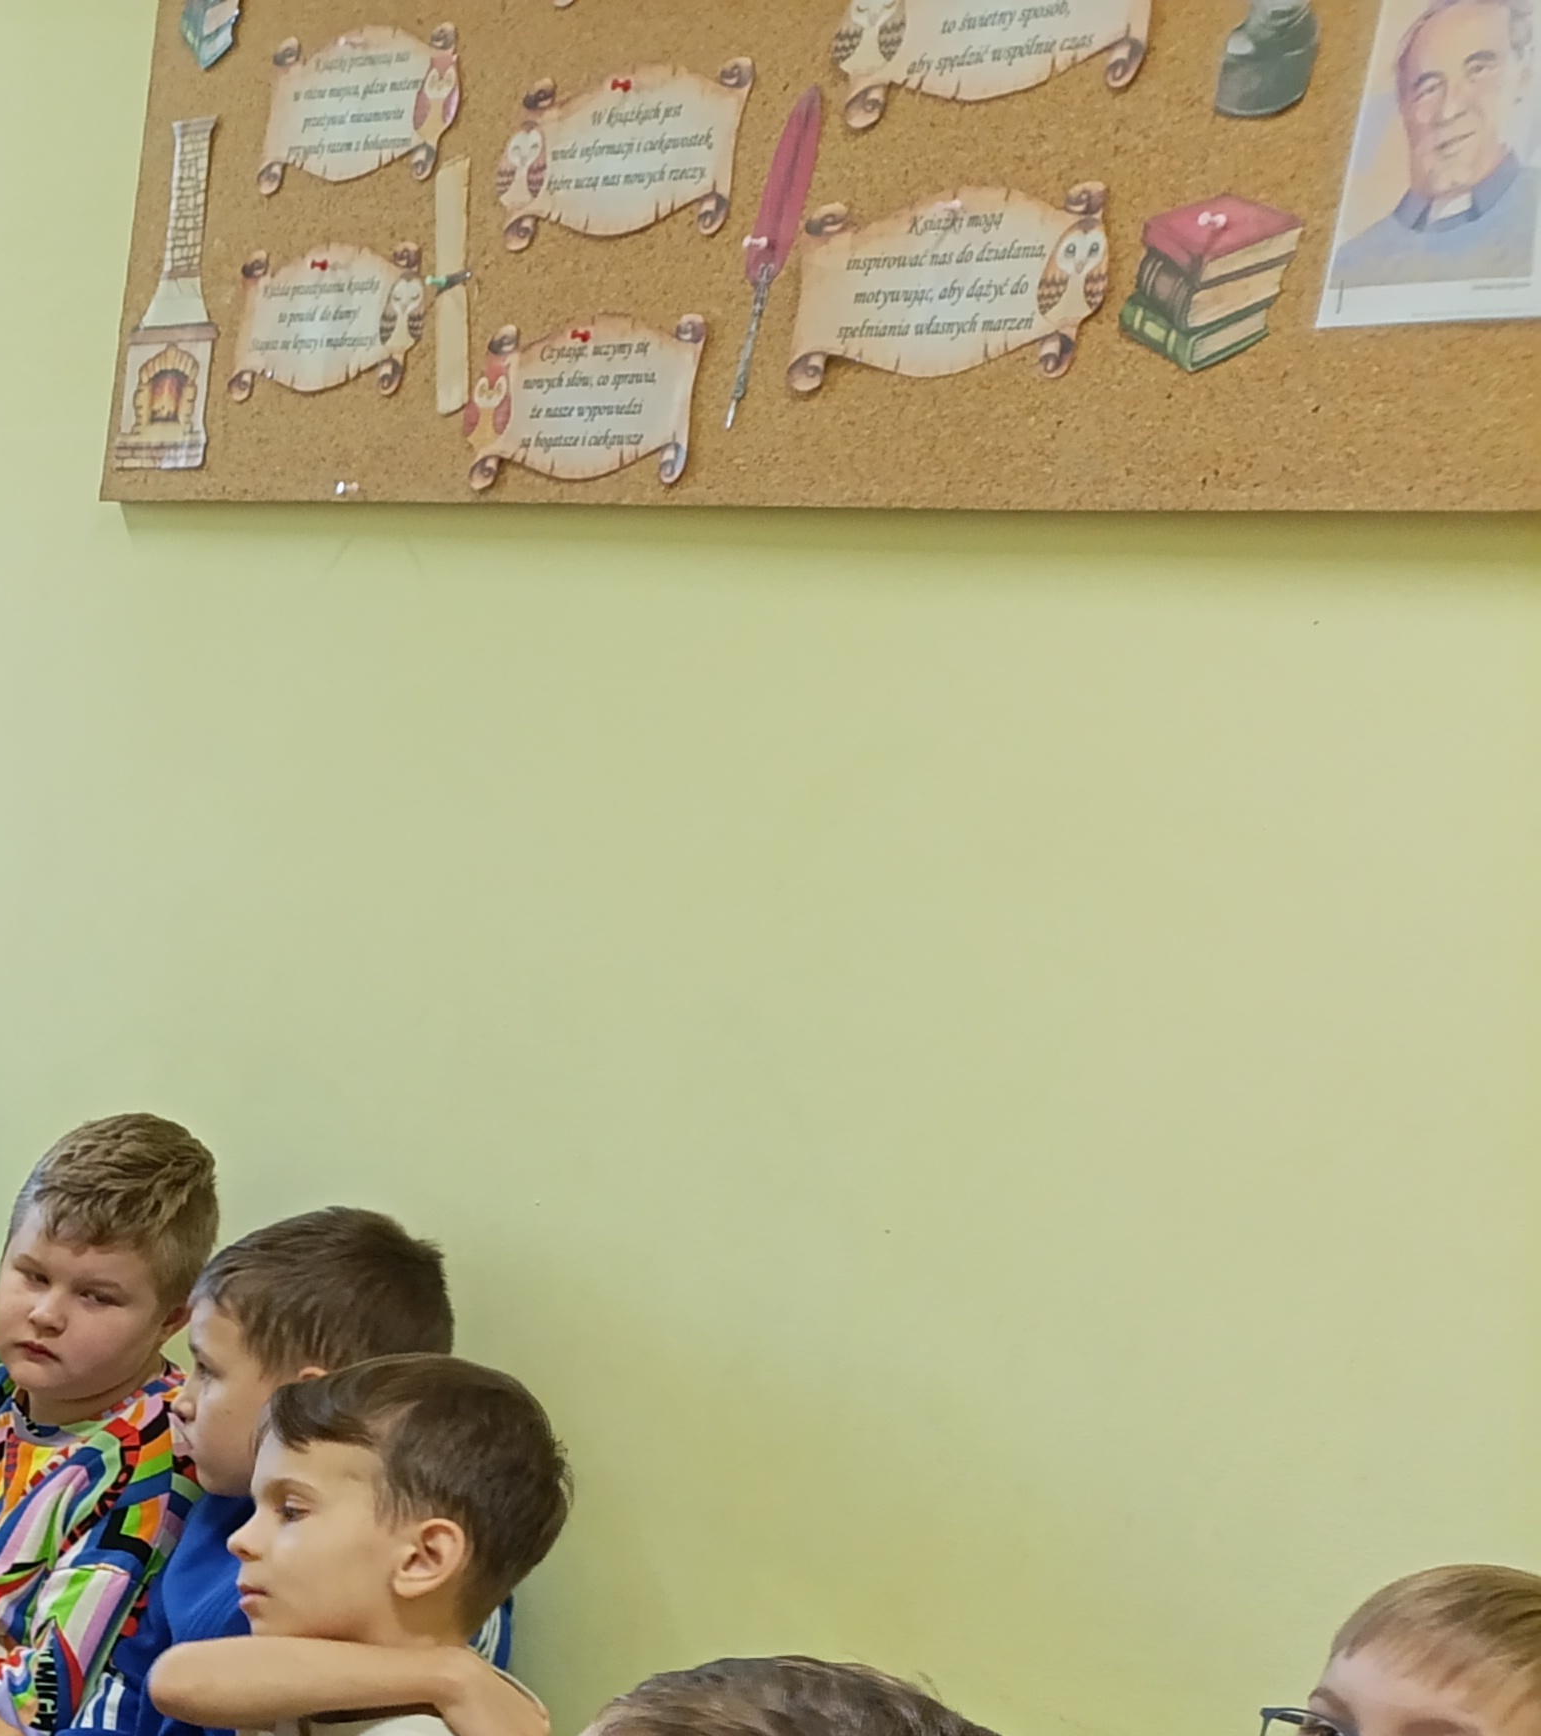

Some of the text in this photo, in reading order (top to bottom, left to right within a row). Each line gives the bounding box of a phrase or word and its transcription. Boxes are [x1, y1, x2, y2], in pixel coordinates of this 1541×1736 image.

[941, 0, 1072, 34] to świetny sposób,
[907, 31, 1095, 77] aby spędzić wspólnie czas
[591, 102, 682, 127] W książkach jest
[551, 141, 576, 161] wiele
[578, 139, 633, 162] informacji
[546, 175, 571, 194] które
[573, 173, 599, 191] uczą
[601, 171, 620, 186] nas
[622, 163, 667, 189] nowych
[908, 209, 1004, 235] Książki mogą
[846, 239, 1046, 276] inspirować nas do działania,
[853, 274, 1028, 310] motywując, aby dążyć do
[835, 311, 1034, 342] spełniania własnych marzeń
[540, 340, 649, 363] Czytając, uczymy się
[522, 370, 656, 393] nowych słów, co sprawia,
[529, 397, 643, 422] że nasze wypowiedzi
[519, 434, 532, 449] są
[534, 430, 578, 451] bogatsze
[587, 428, 643, 450] ciekawsze
